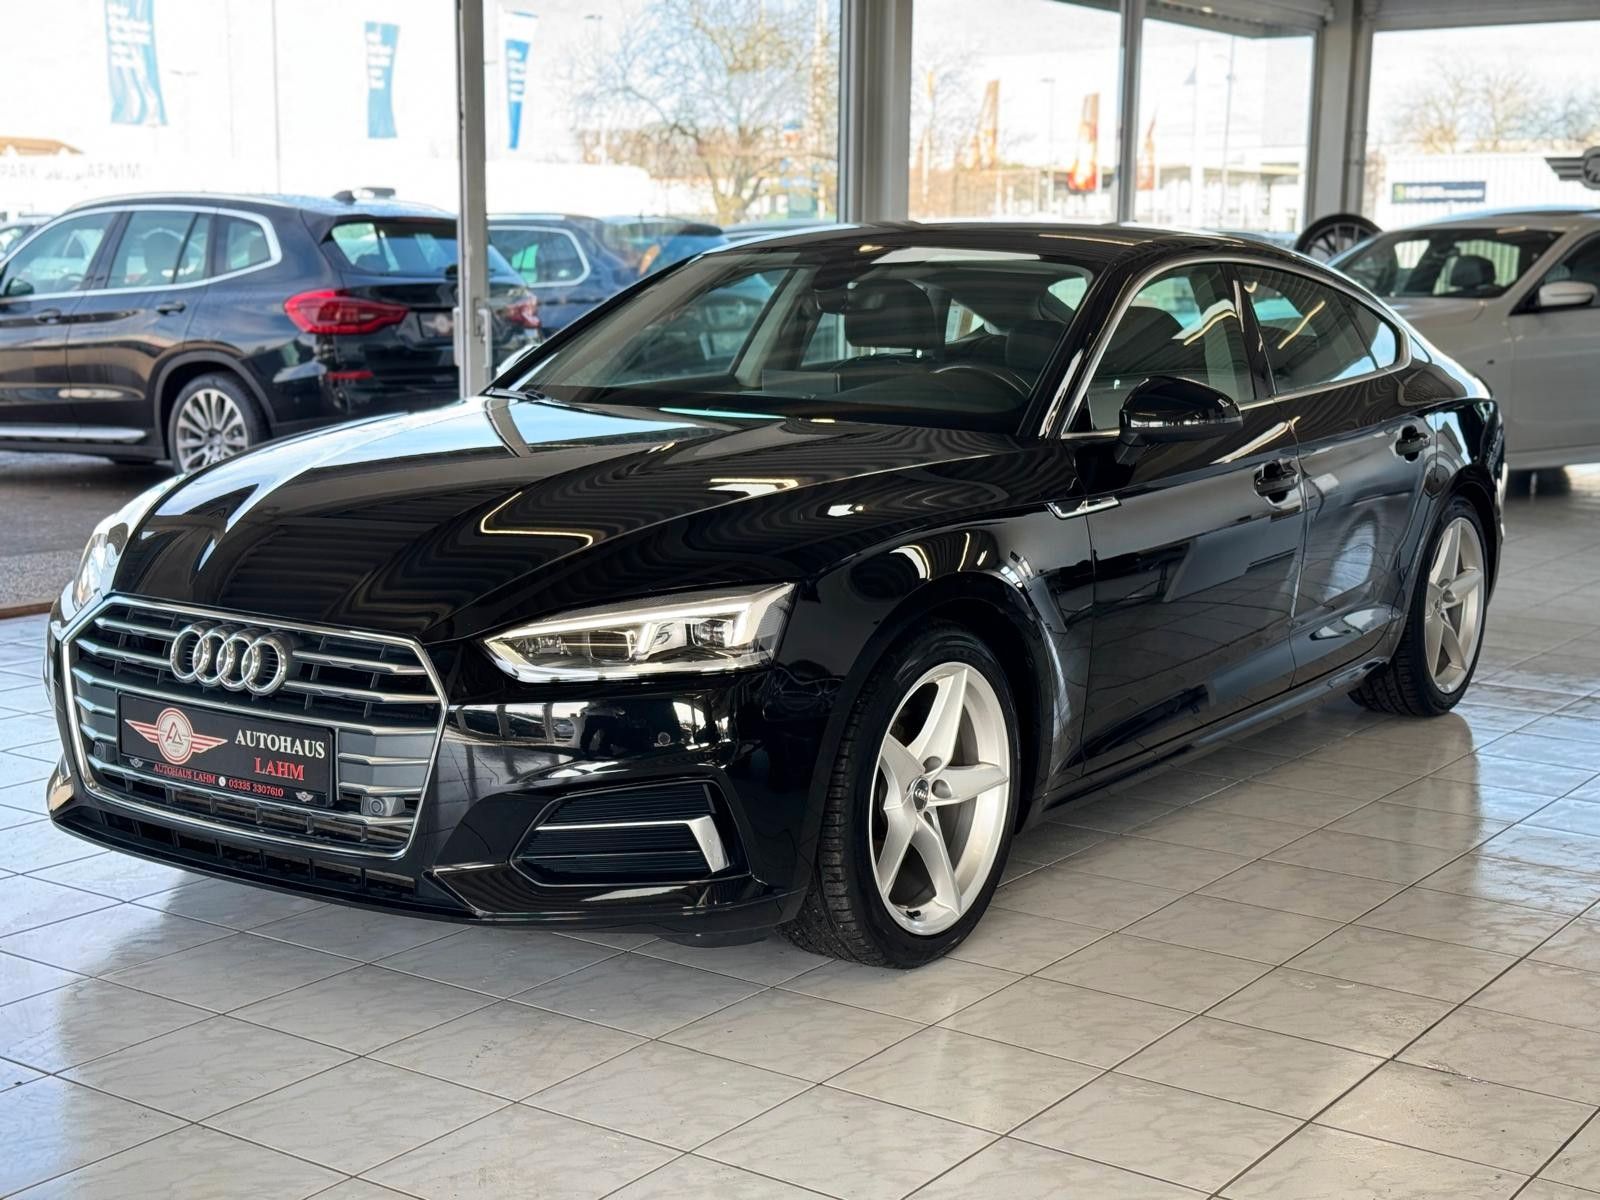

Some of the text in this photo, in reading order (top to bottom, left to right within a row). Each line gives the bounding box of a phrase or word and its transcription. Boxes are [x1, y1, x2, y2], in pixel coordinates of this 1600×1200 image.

[235, 729, 325, 759] AUTOHAUS
[153, 763, 284, 797] AUTOHAUS LAHM 03335 3307610
[254, 757, 304, 781] LAHM
